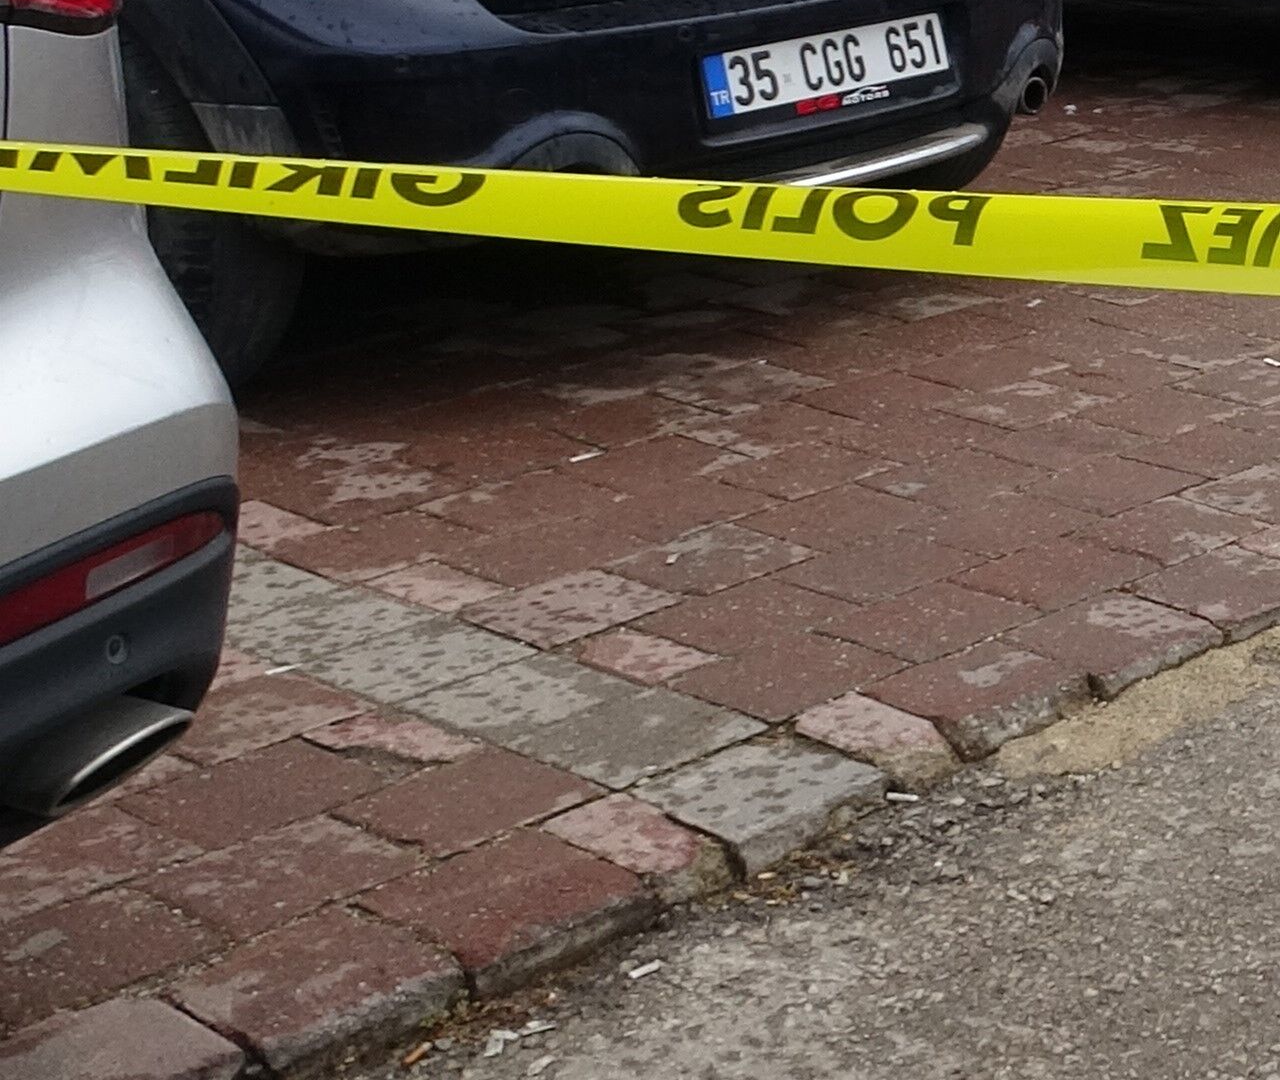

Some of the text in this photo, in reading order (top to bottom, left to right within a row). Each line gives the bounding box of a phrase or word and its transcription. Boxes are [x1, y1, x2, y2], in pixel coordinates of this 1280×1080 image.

[729, 18, 941, 107] 35 CGG 651
